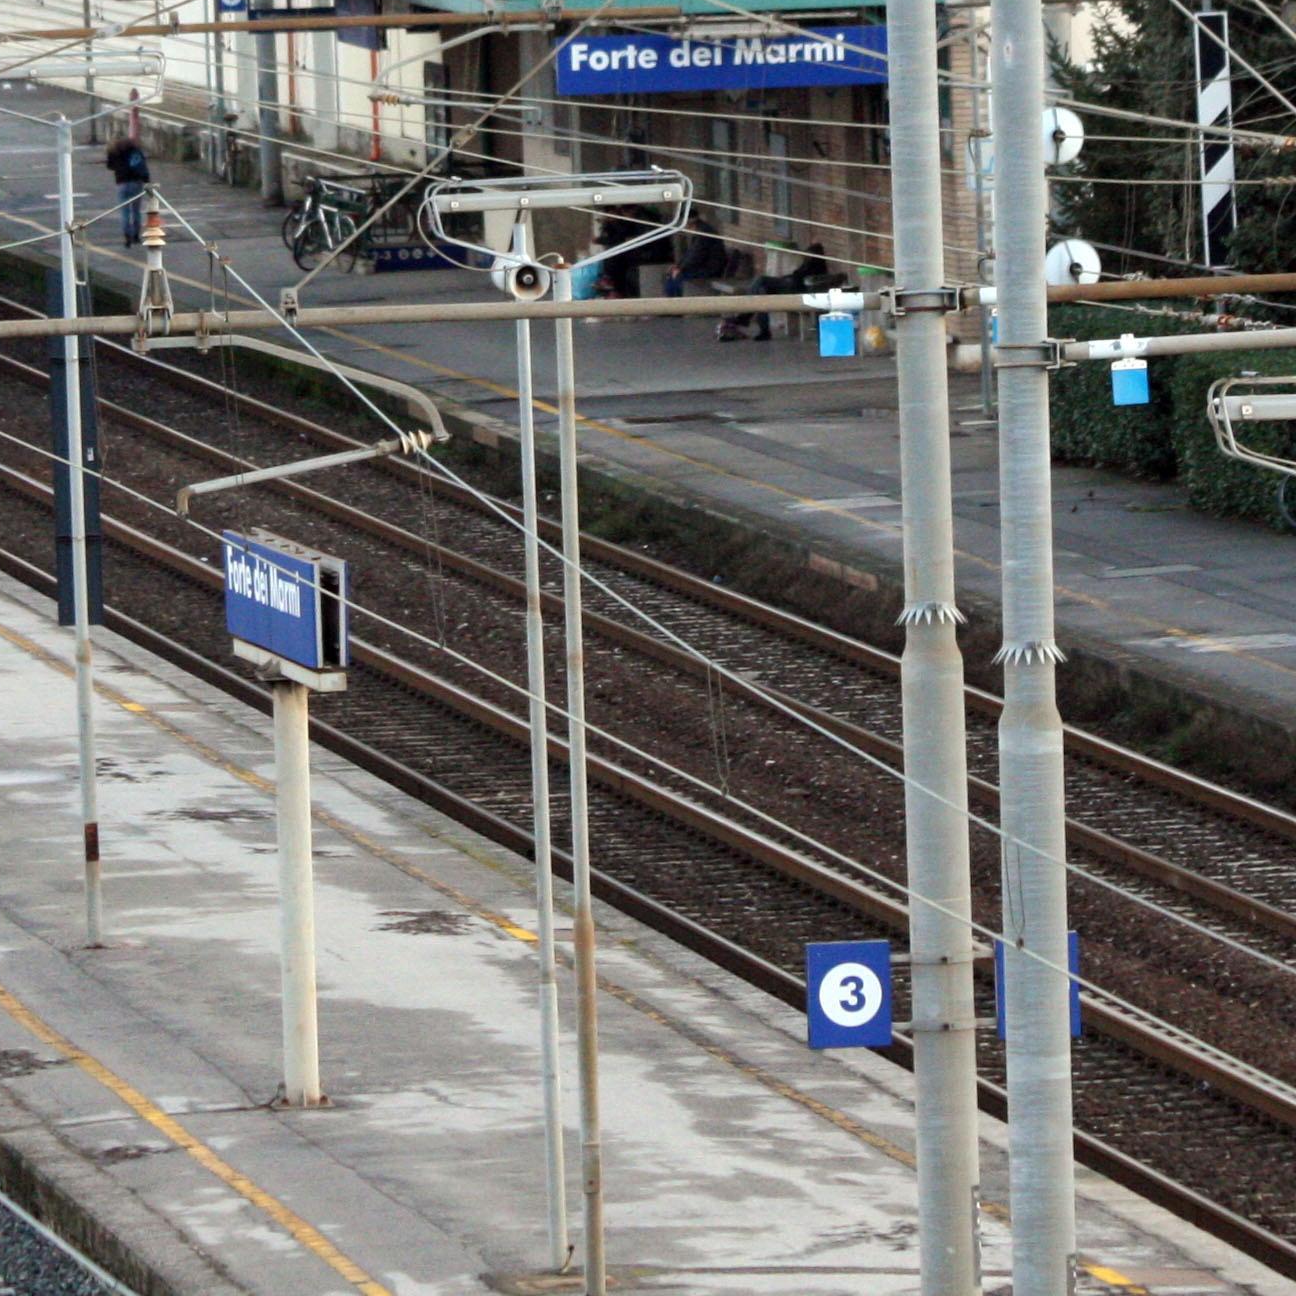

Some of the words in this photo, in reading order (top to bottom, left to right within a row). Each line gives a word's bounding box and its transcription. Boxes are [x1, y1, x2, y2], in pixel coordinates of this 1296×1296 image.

[570, 43, 658, 71] Forte
[670, 38, 722, 68] dei
[733, 34, 845, 65] Marmi
[226, 545, 252, 599] Forte
[254, 554, 268, 606] dei
[269, 565, 301, 618] Marmi
[839, 976, 866, 1012] 3
